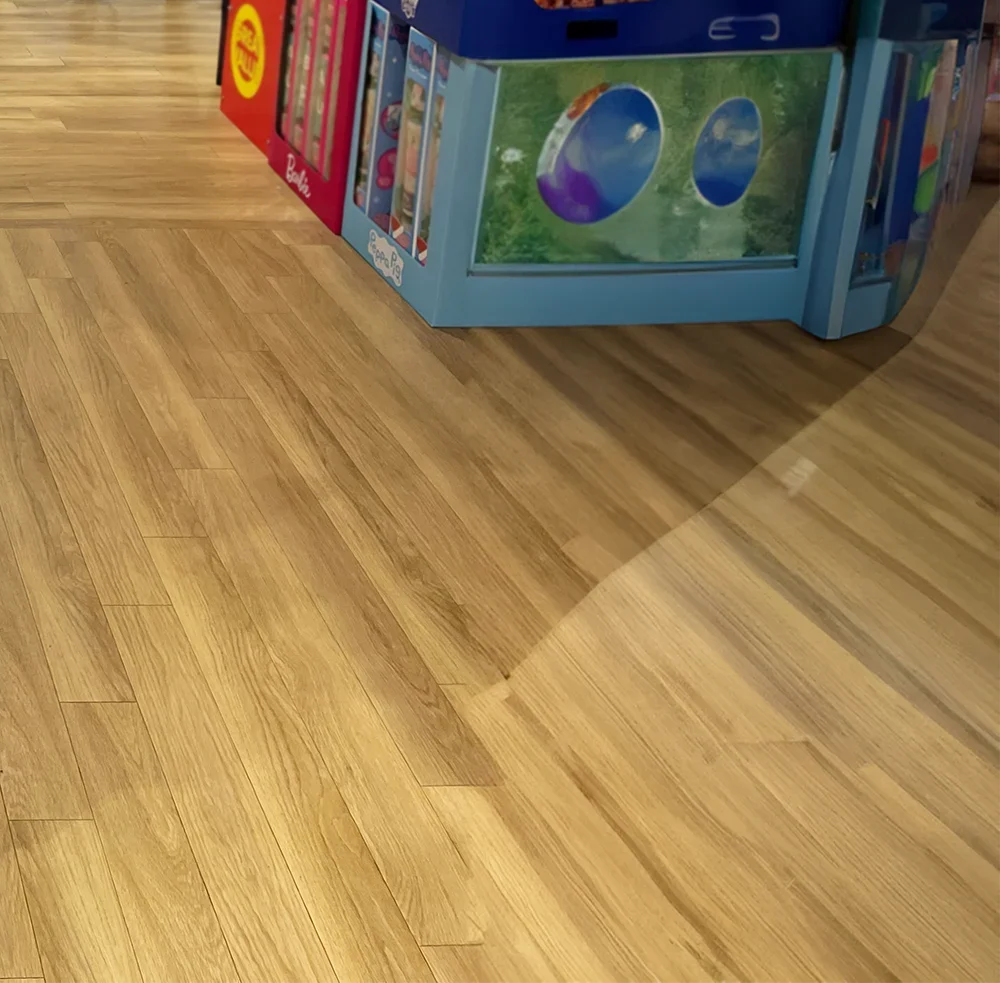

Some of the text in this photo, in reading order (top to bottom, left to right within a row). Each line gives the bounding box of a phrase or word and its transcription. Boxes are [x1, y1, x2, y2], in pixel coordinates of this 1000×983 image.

[286, 153, 311, 198] Barbie
[370, 232, 401, 279] Peppa Pig
